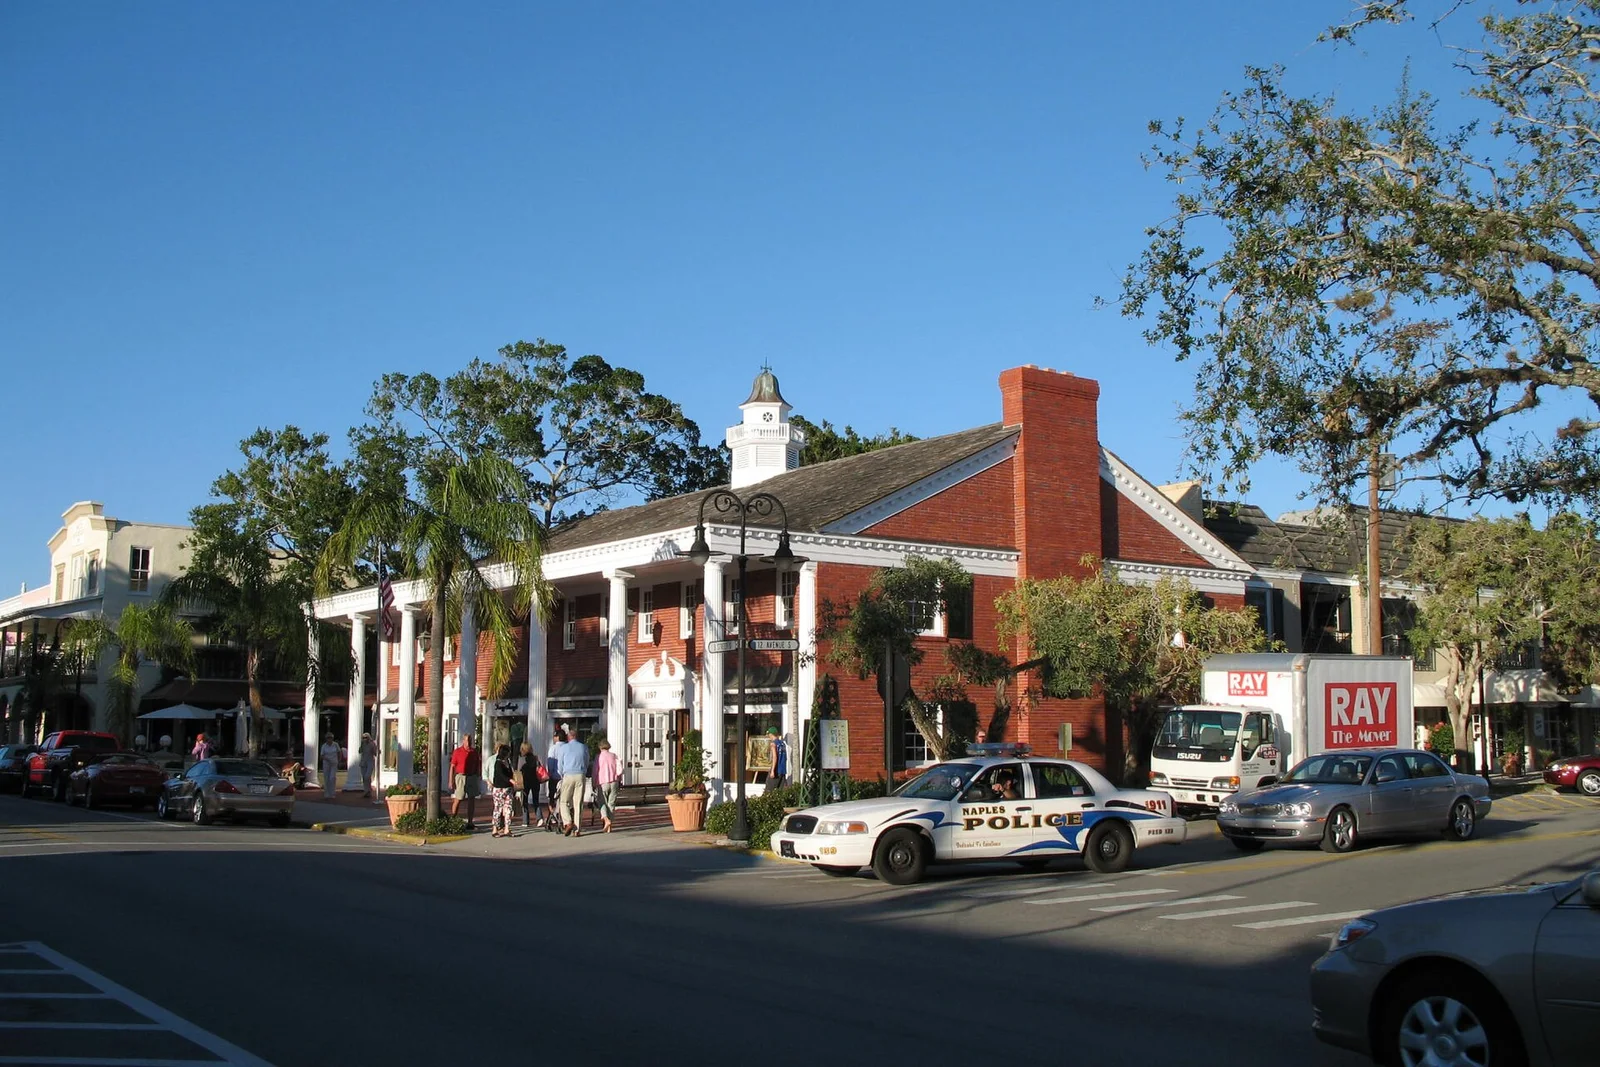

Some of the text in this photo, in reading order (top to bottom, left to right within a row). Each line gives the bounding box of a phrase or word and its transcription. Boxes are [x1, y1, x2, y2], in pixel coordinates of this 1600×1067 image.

[1230, 673, 1265, 689] RAY
[645, 691, 657, 699] 1197
[1331, 687, 1391, 726] RAY
[1331, 730, 1392, 744] The Mover
[1177, 752, 1202, 760] ISUZU
[962, 806, 1005, 815] NAPLES
[1149, 800, 1167, 810] 911
[962, 812, 1083, 831] POLICE
